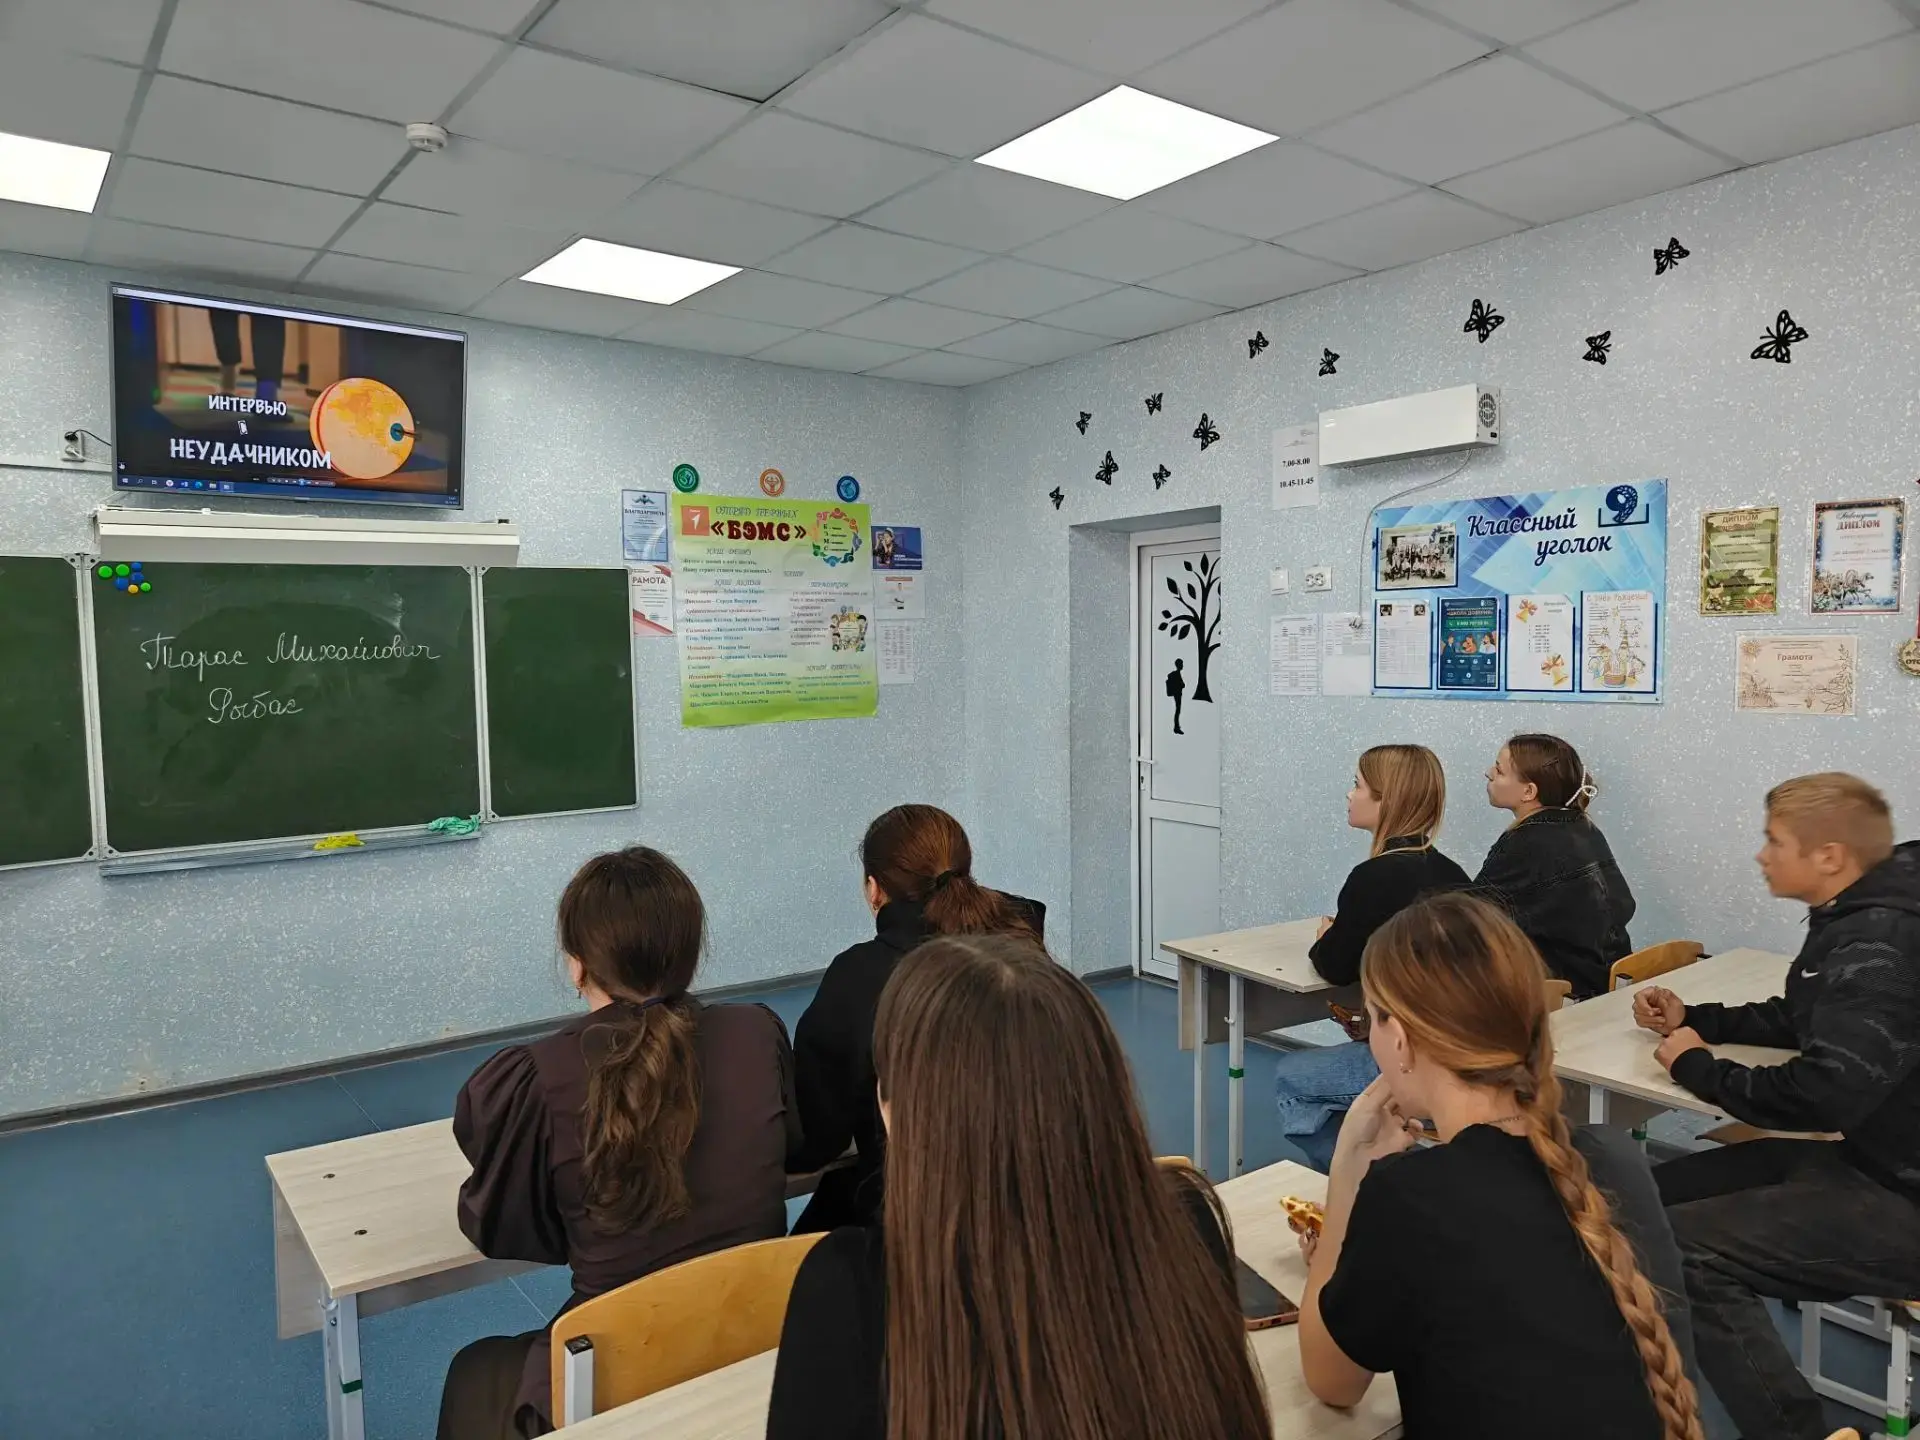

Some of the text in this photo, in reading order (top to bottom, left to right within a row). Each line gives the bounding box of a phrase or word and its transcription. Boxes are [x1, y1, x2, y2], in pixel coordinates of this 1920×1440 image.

[208, 394, 287, 416] ИНТЕРВЬЮ
[170, 438, 332, 470] НЕУДАЧНИКОМ
[1282, 457, 1311, 468] 7.00-8.00
[1280, 477, 1315, 488] 10.45-11.45
[1605, 484, 1639, 524] 9
[1467, 507, 1577, 538] Классный
[1836, 519, 1881, 531] ДИПЛОМ
[1534, 535, 1613, 567] уголок
[632, 577, 667, 585] РАМОТА
[140, 632, 249, 682] Тарас
[1777, 653, 1813, 661] Грамота
